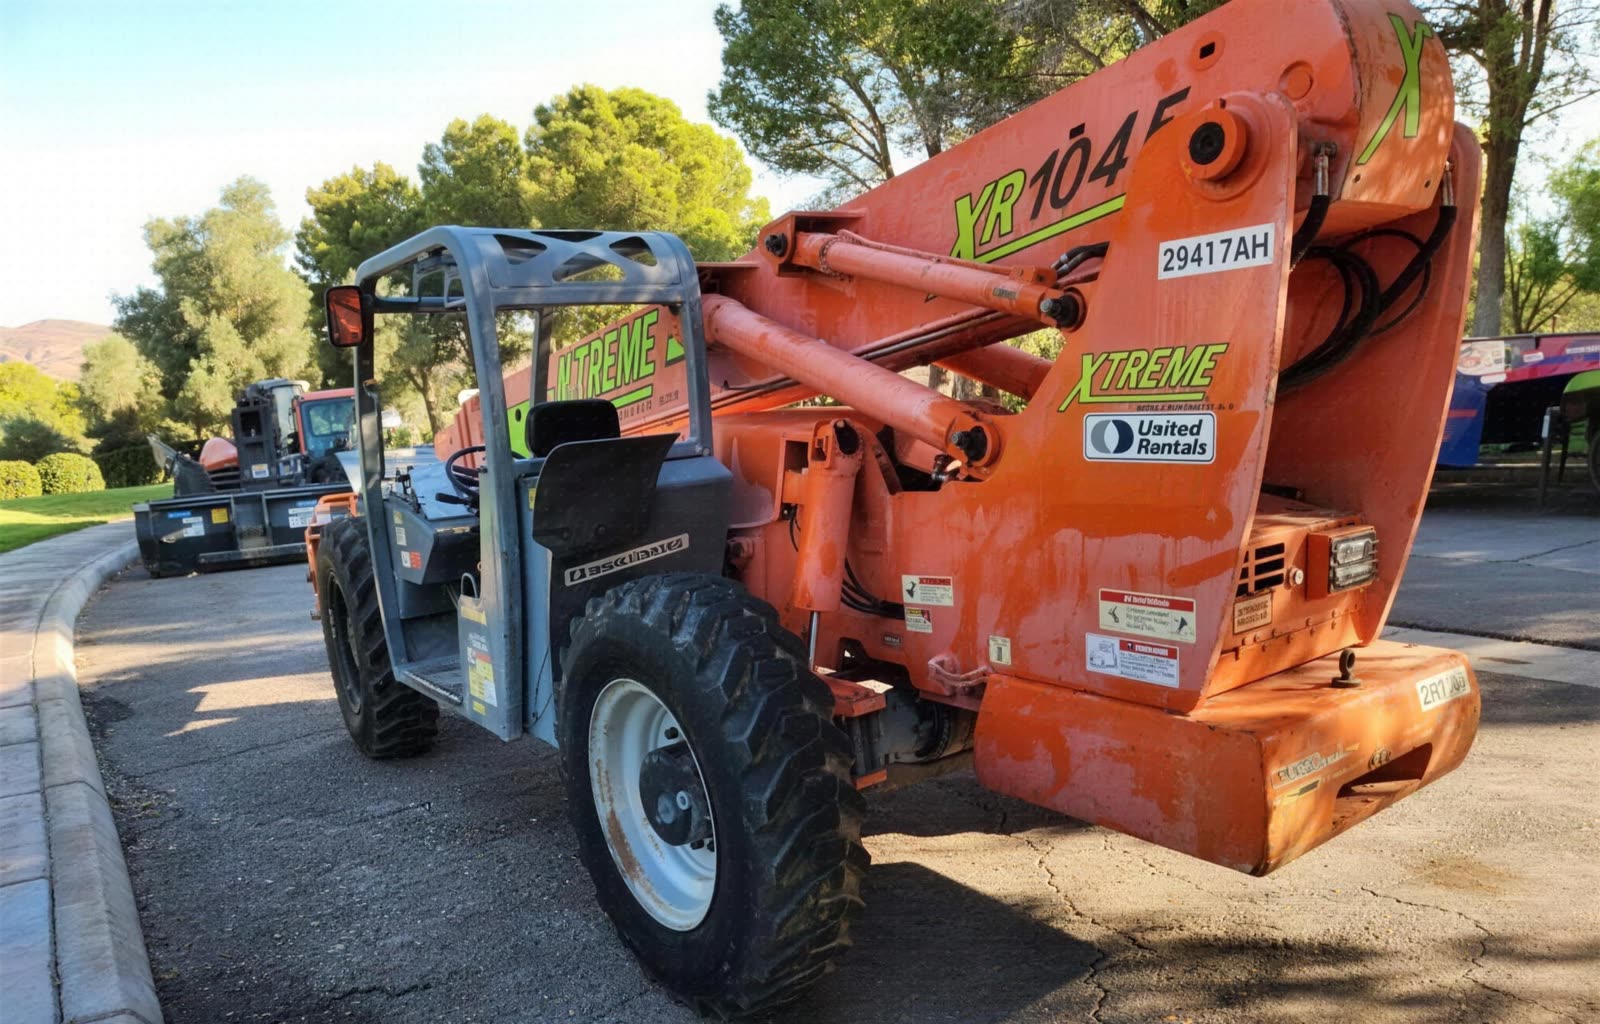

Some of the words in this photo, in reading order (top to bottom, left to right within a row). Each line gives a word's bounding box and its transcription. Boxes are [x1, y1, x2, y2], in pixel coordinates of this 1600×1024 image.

[1162, 232, 1269, 273] 29417AH
[1057, 343, 1229, 413] XTREME
[1137, 438, 1208, 456] Rentals
